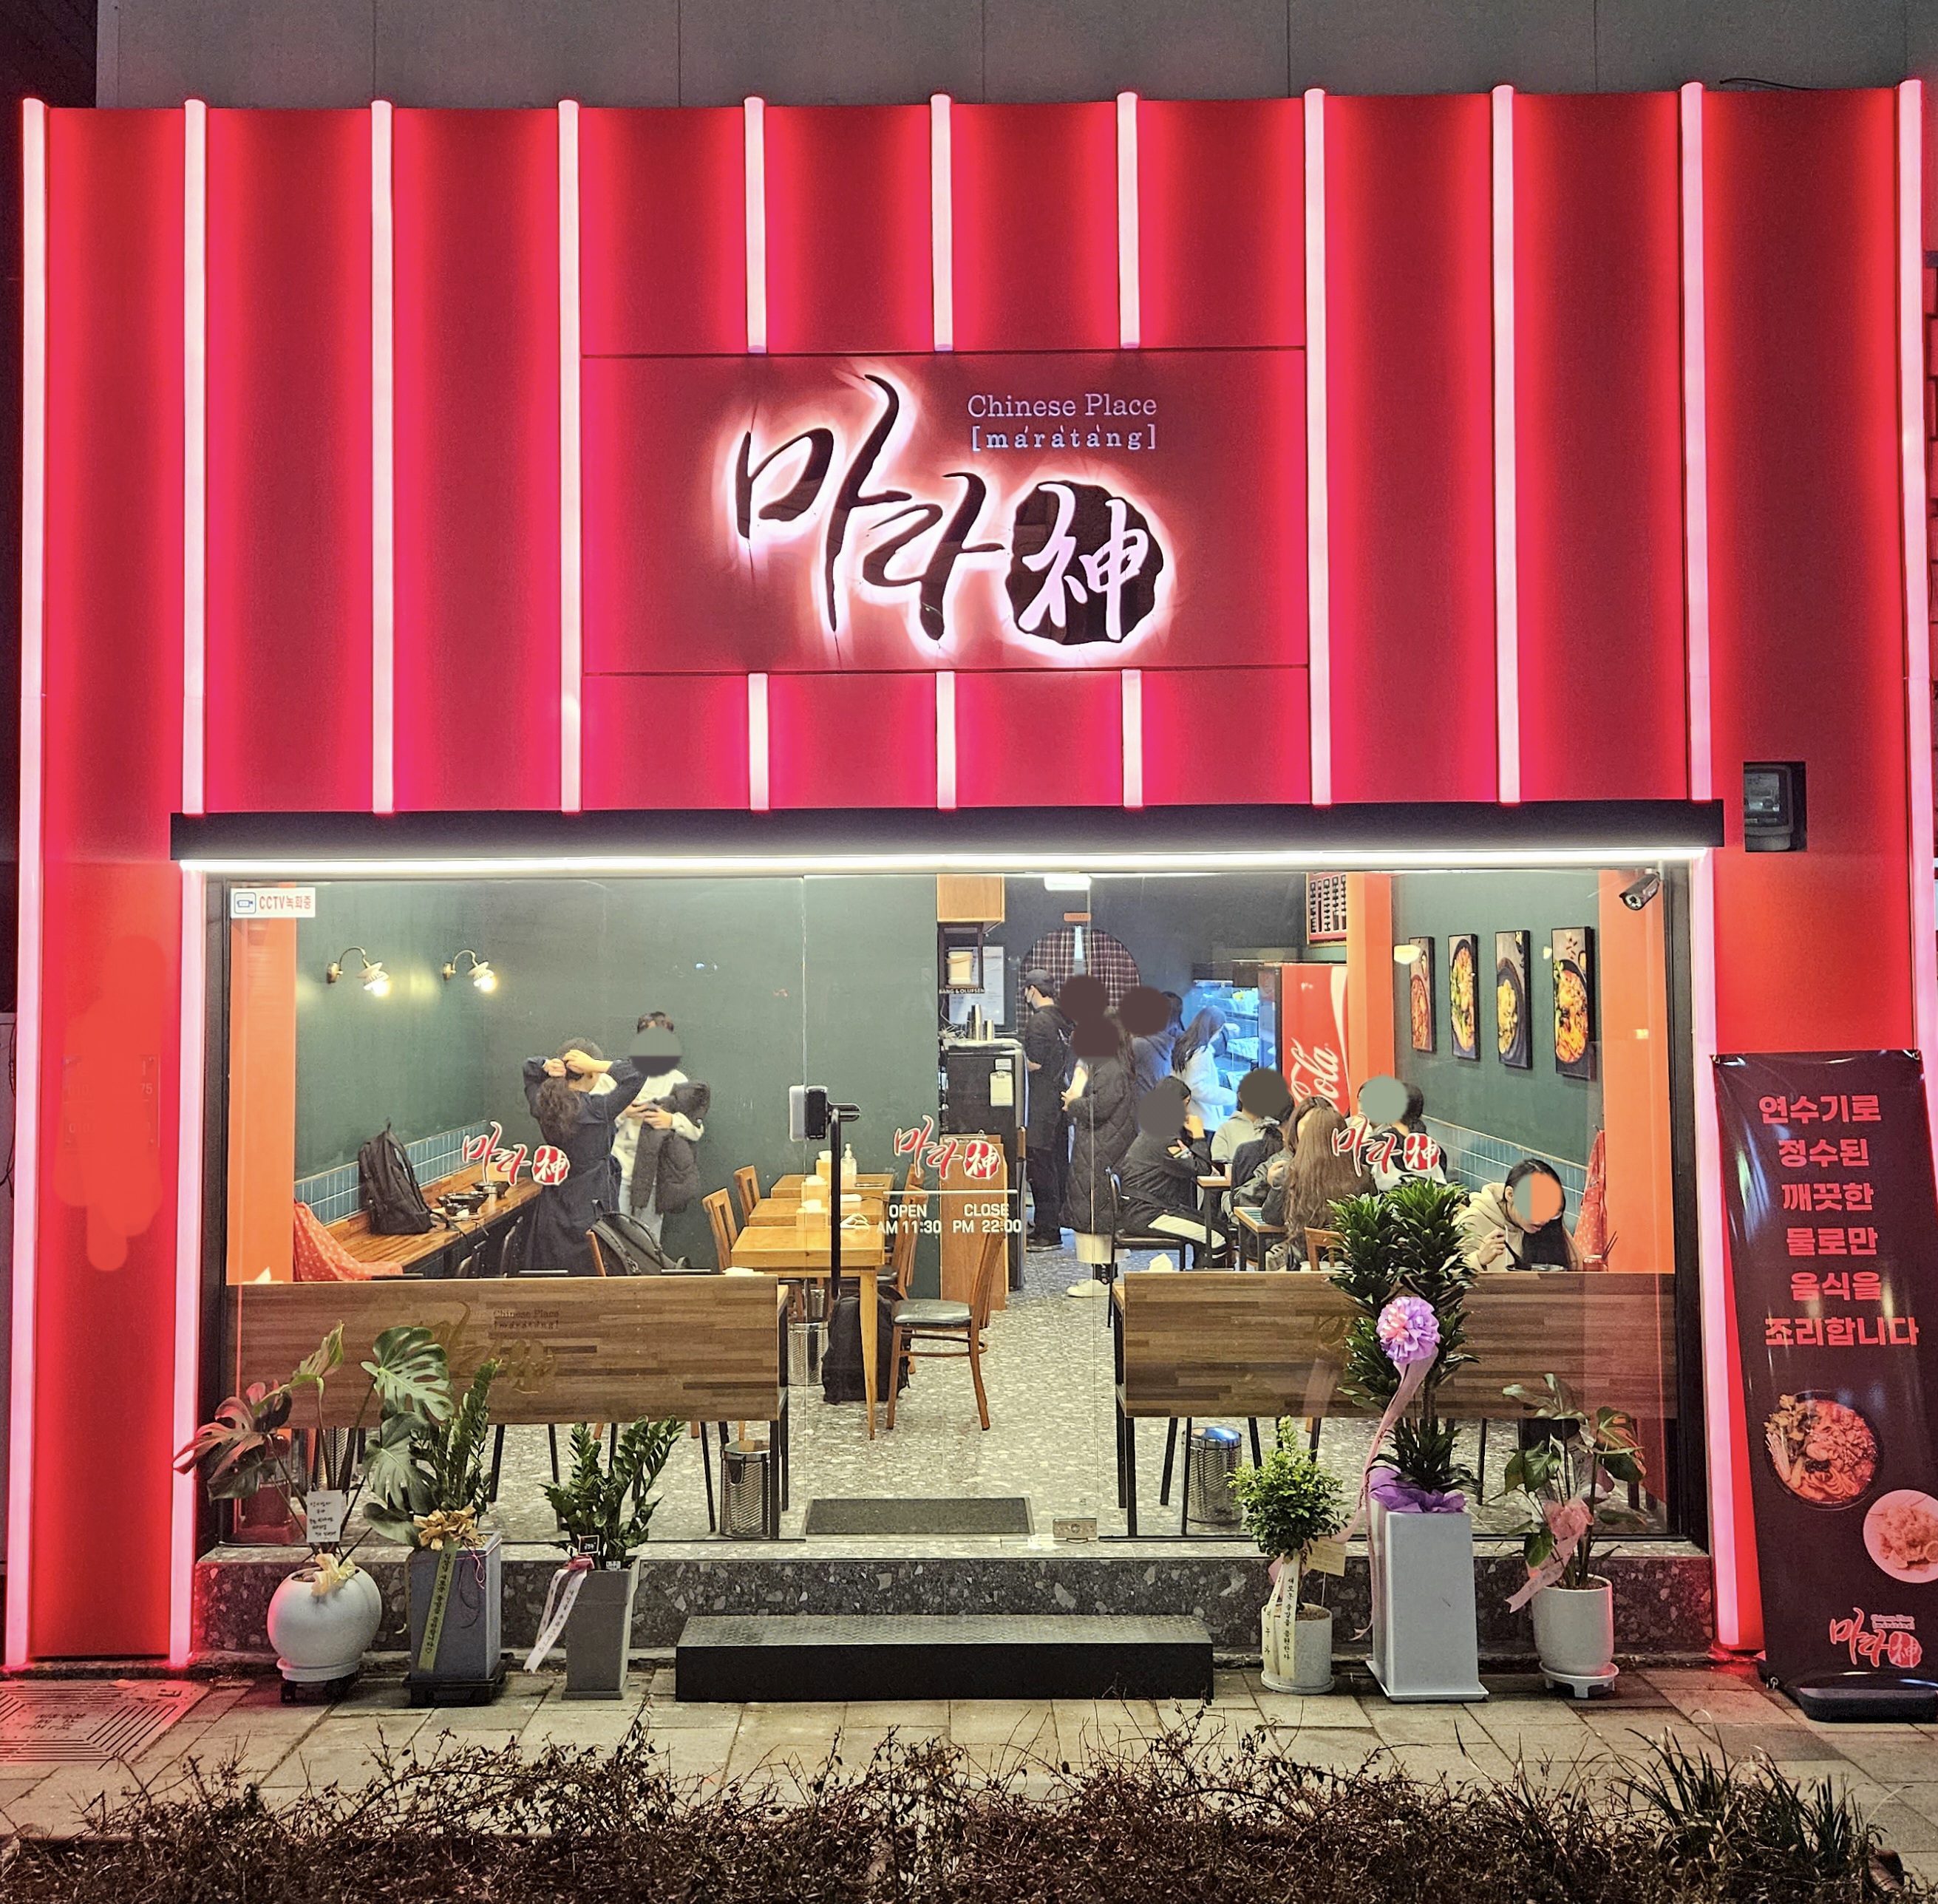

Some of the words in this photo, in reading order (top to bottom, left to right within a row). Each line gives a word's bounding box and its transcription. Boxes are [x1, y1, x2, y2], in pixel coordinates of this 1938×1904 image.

[968, 394, 1076, 418] Chinese
[1084, 392, 1157, 416] Place
[1759, 1095, 1882, 1124] 연수기로
[1778, 1138, 1870, 1168] 정수된
[888, 1204, 928, 1218] OPEN
[964, 1203, 1010, 1217] CLOSE
[1782, 1183, 1874, 1211] 깨끗한
[877, 1220, 898, 1234] AM
[902, 1220, 942, 1234] 11:30
[952, 1220, 974, 1233] PM
[982, 1219, 1022, 1233] 22:00
[1786, 1227, 1877, 1256] 물로만
[1790, 1271, 1882, 1301] 음식을
[1765, 1316, 1920, 1346] 조리합니다
